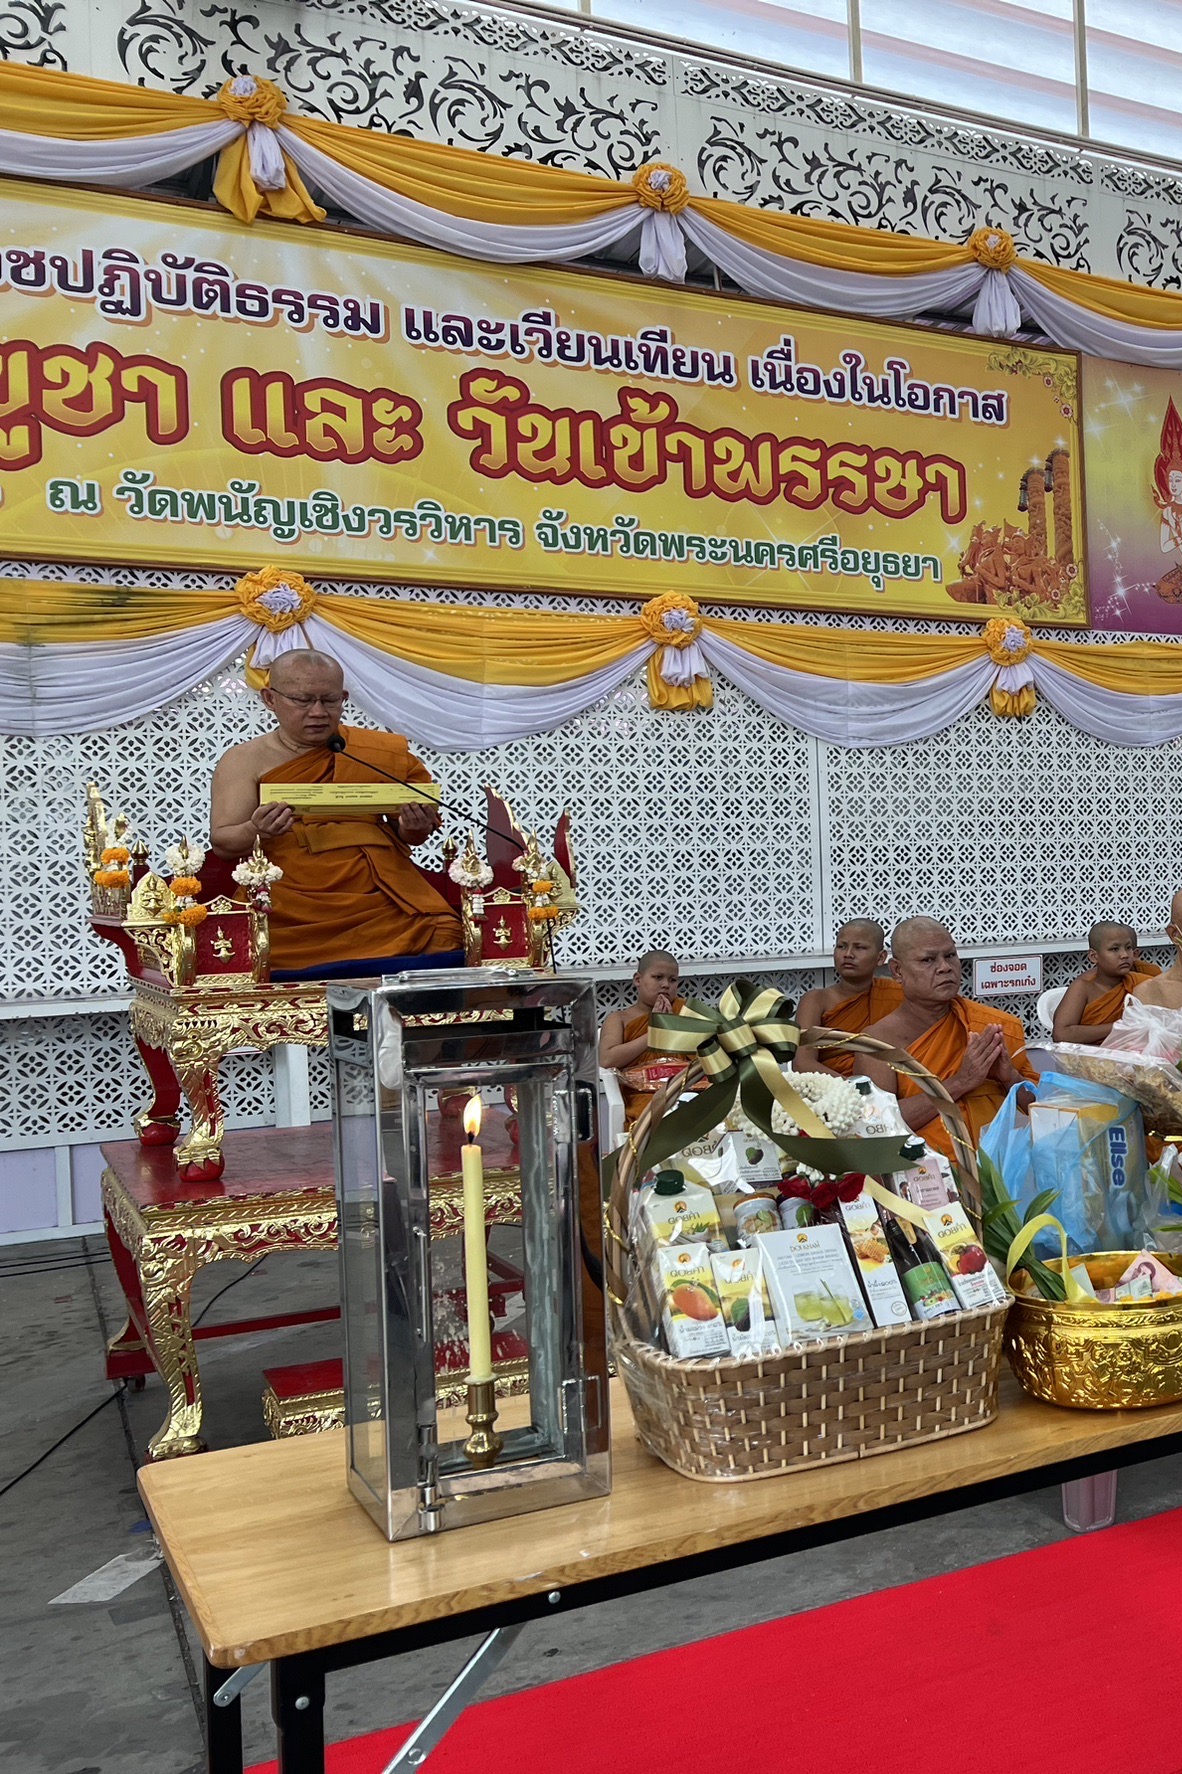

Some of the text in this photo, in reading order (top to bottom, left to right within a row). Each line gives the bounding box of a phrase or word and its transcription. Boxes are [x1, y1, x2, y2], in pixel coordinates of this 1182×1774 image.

[0, 246, 1006, 423] ชปฏิบัติธรรม และเวียนเทียน เนื่องในโอกาส
[227, 371, 417, 459] และ
[452, 373, 964, 520] วันเข้าพรรษา
[49, 470, 940, 587] ณ วัดพนัญเชิงวรวิหาร จังหวัดพระนครศรีอยุธยา
[989, 961, 1027, 973] ช่องจอด
[1108, 1126, 1128, 1187] Ellse
